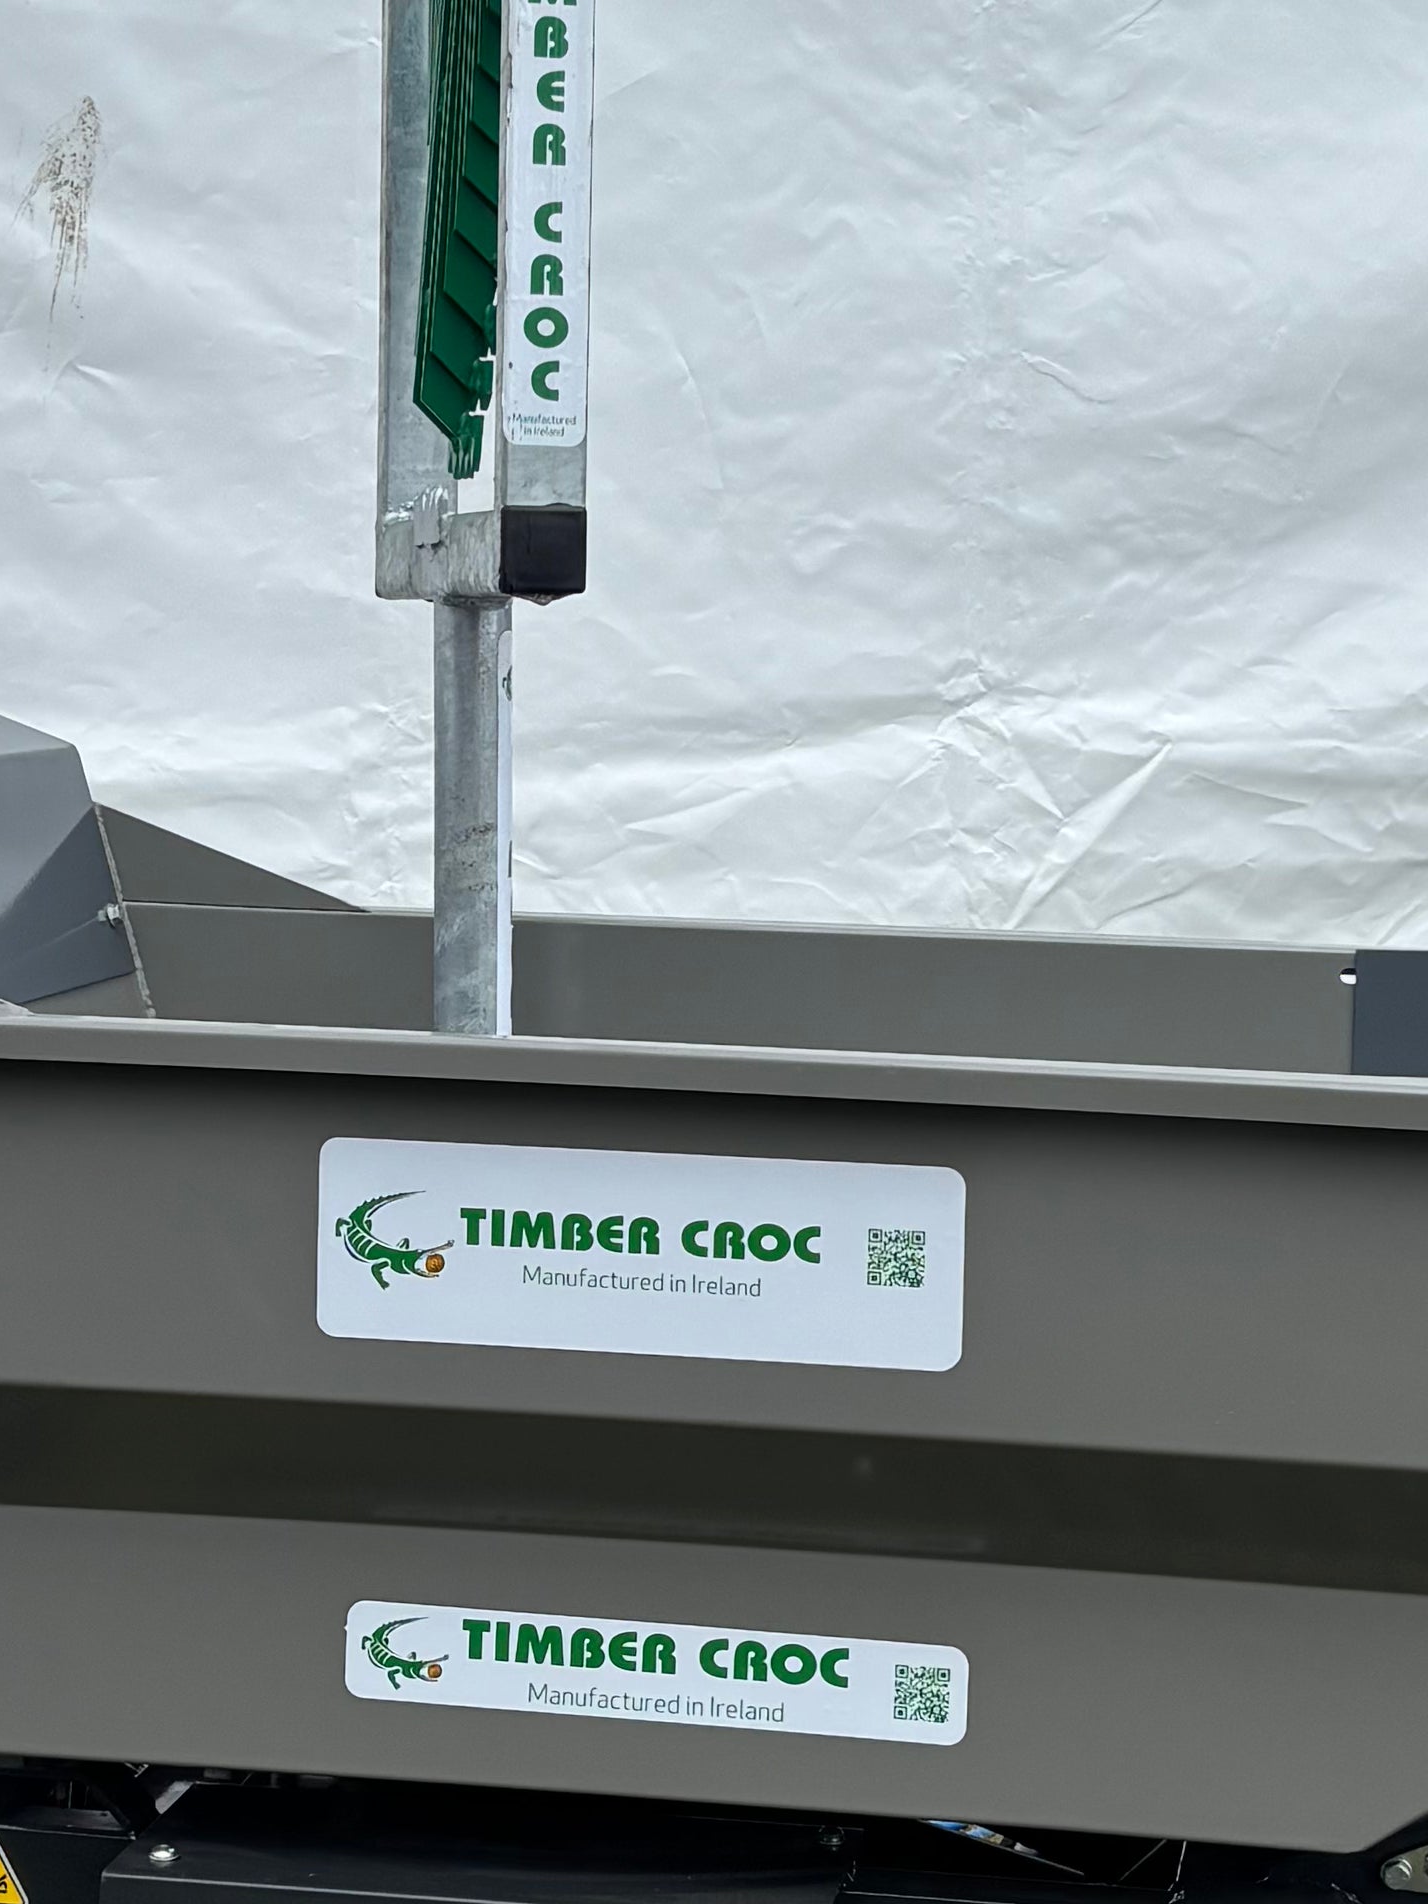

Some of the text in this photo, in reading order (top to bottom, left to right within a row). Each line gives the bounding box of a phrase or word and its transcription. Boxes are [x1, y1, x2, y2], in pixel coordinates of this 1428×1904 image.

[523, 201, 569, 402] CROC
[512, 412, 577, 426] Manufactured
[523, 425, 565, 438] in Ireland
[459, 1206, 822, 1265] TIMBER CROC
[521, 1264, 762, 1298] Manufactured in Ireland
[462, 1618, 850, 1689] TIMBER CROC
[527, 1682, 785, 1724] Manufactured in Ireland
